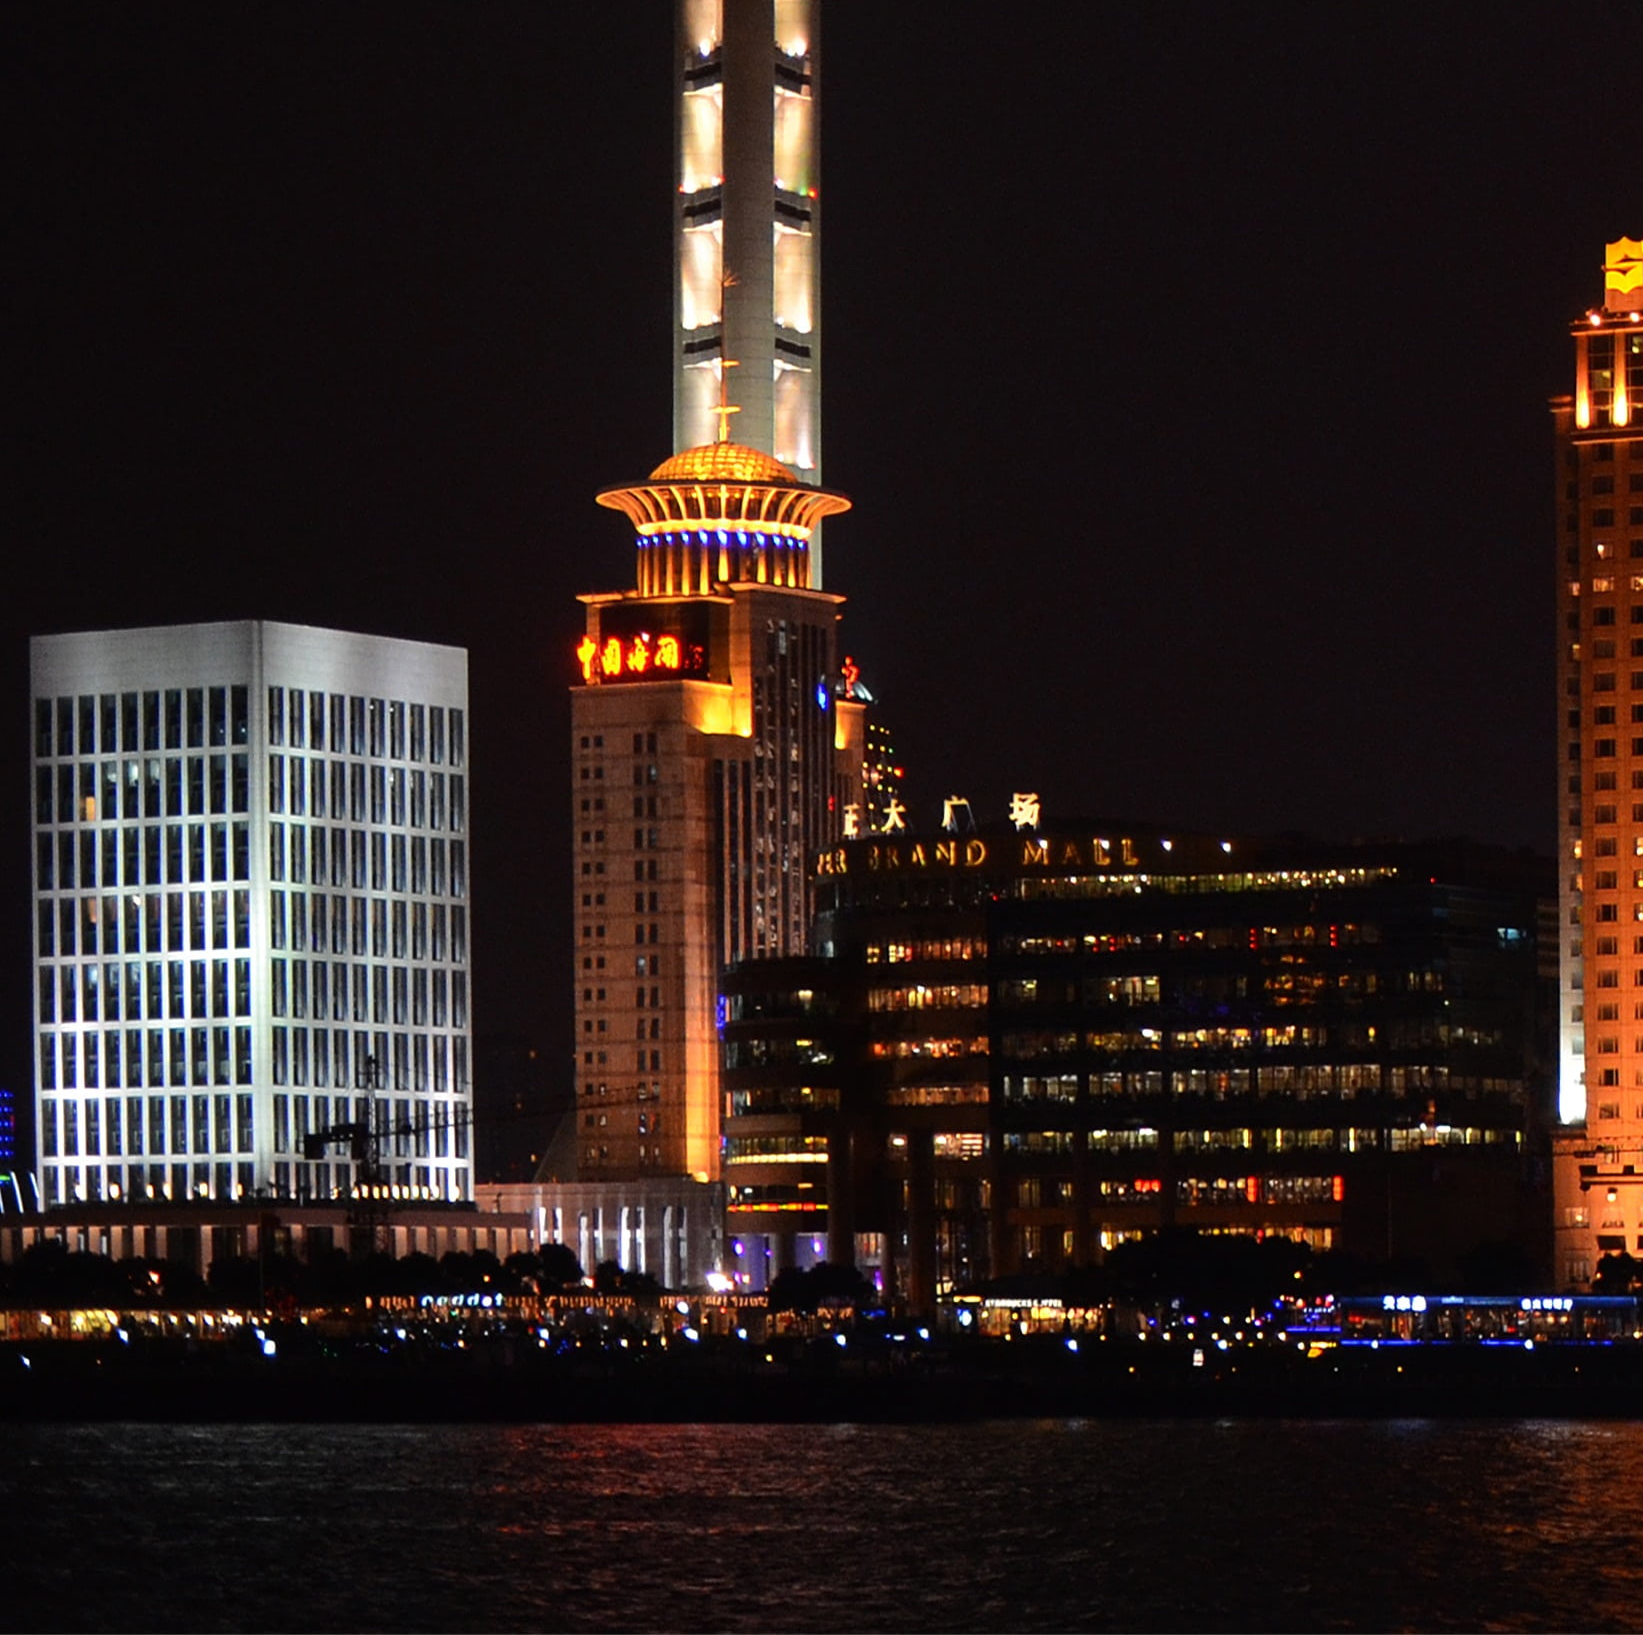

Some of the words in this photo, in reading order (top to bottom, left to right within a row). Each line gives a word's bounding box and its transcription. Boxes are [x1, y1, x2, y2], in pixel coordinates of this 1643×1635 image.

[842, 792, 1041, 836] 正大广场
[869, 840, 987, 869] BRAND
[1022, 838, 1139, 867] MALL
